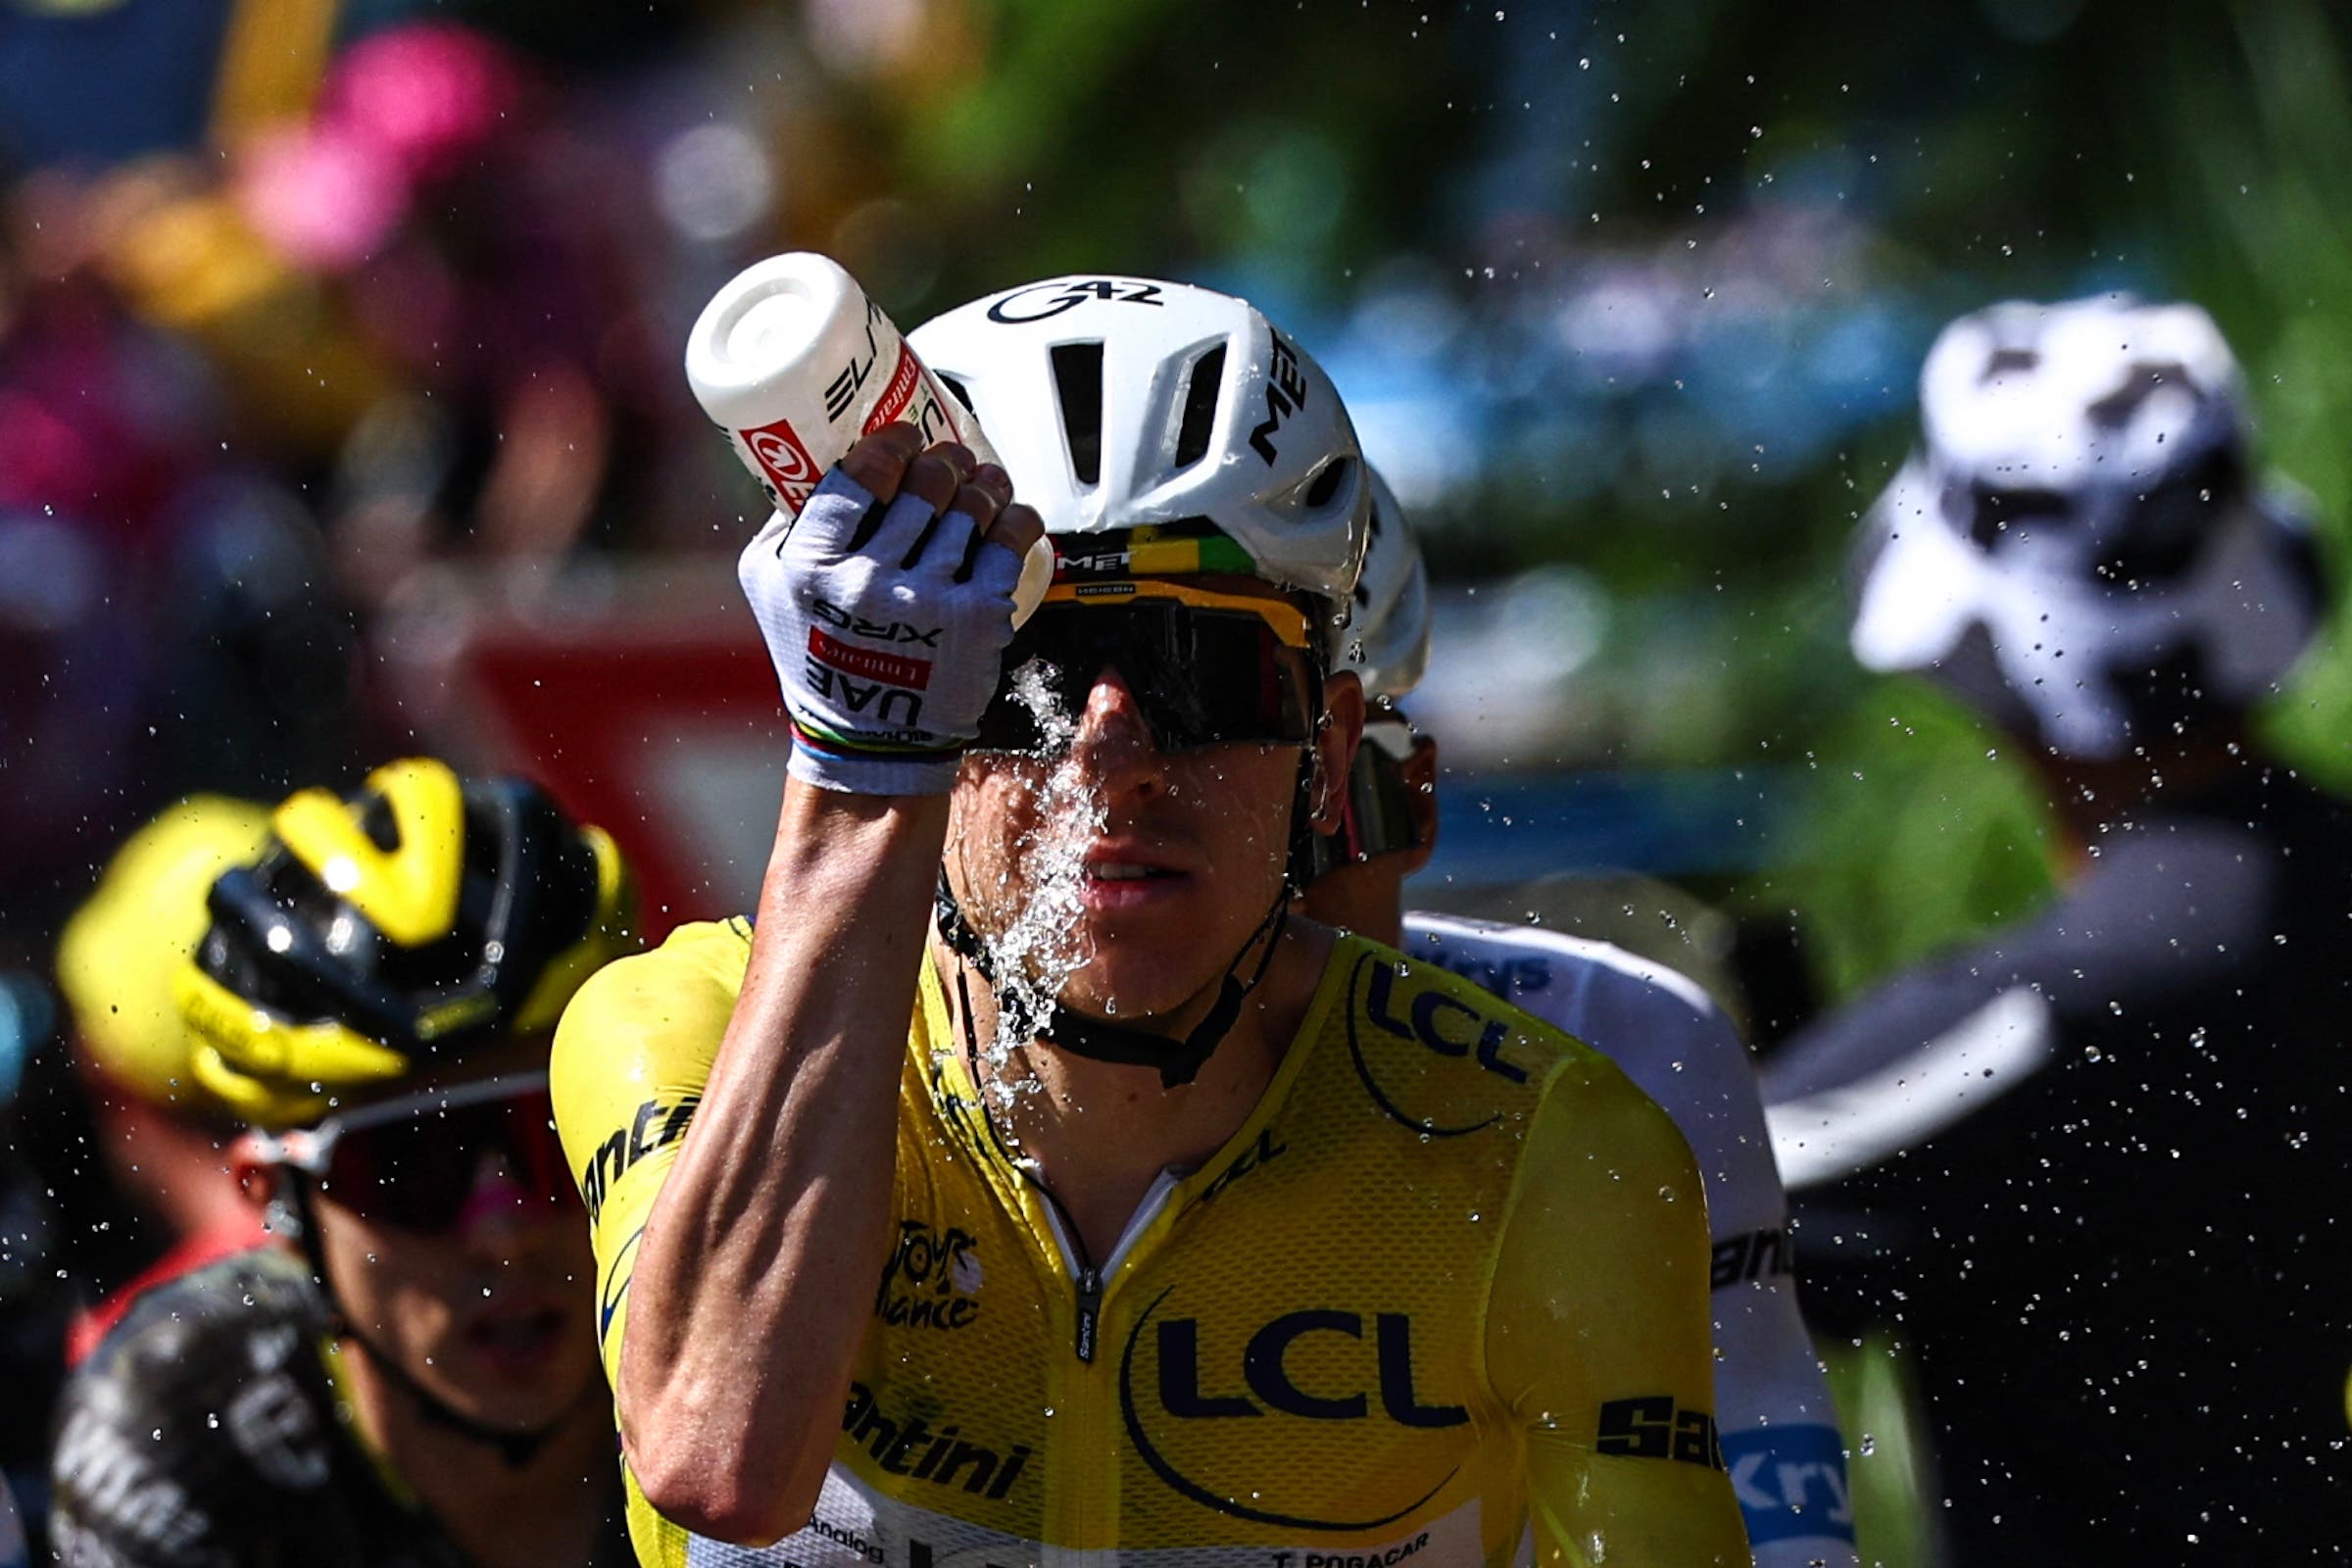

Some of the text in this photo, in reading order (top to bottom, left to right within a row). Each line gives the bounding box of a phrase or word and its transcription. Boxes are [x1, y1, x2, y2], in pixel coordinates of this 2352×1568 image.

[824, 296, 883, 423] ELIT
[1056, 551, 1131, 571] MET
[811, 599, 944, 647] XRG
[806, 656, 923, 728] UAE
[1365, 959, 1528, 1084] LCL
[1156, 1309, 1470, 1428] LCL
[841, 1381, 1031, 1499] antini
[808, 1513, 884, 1565] Analog
